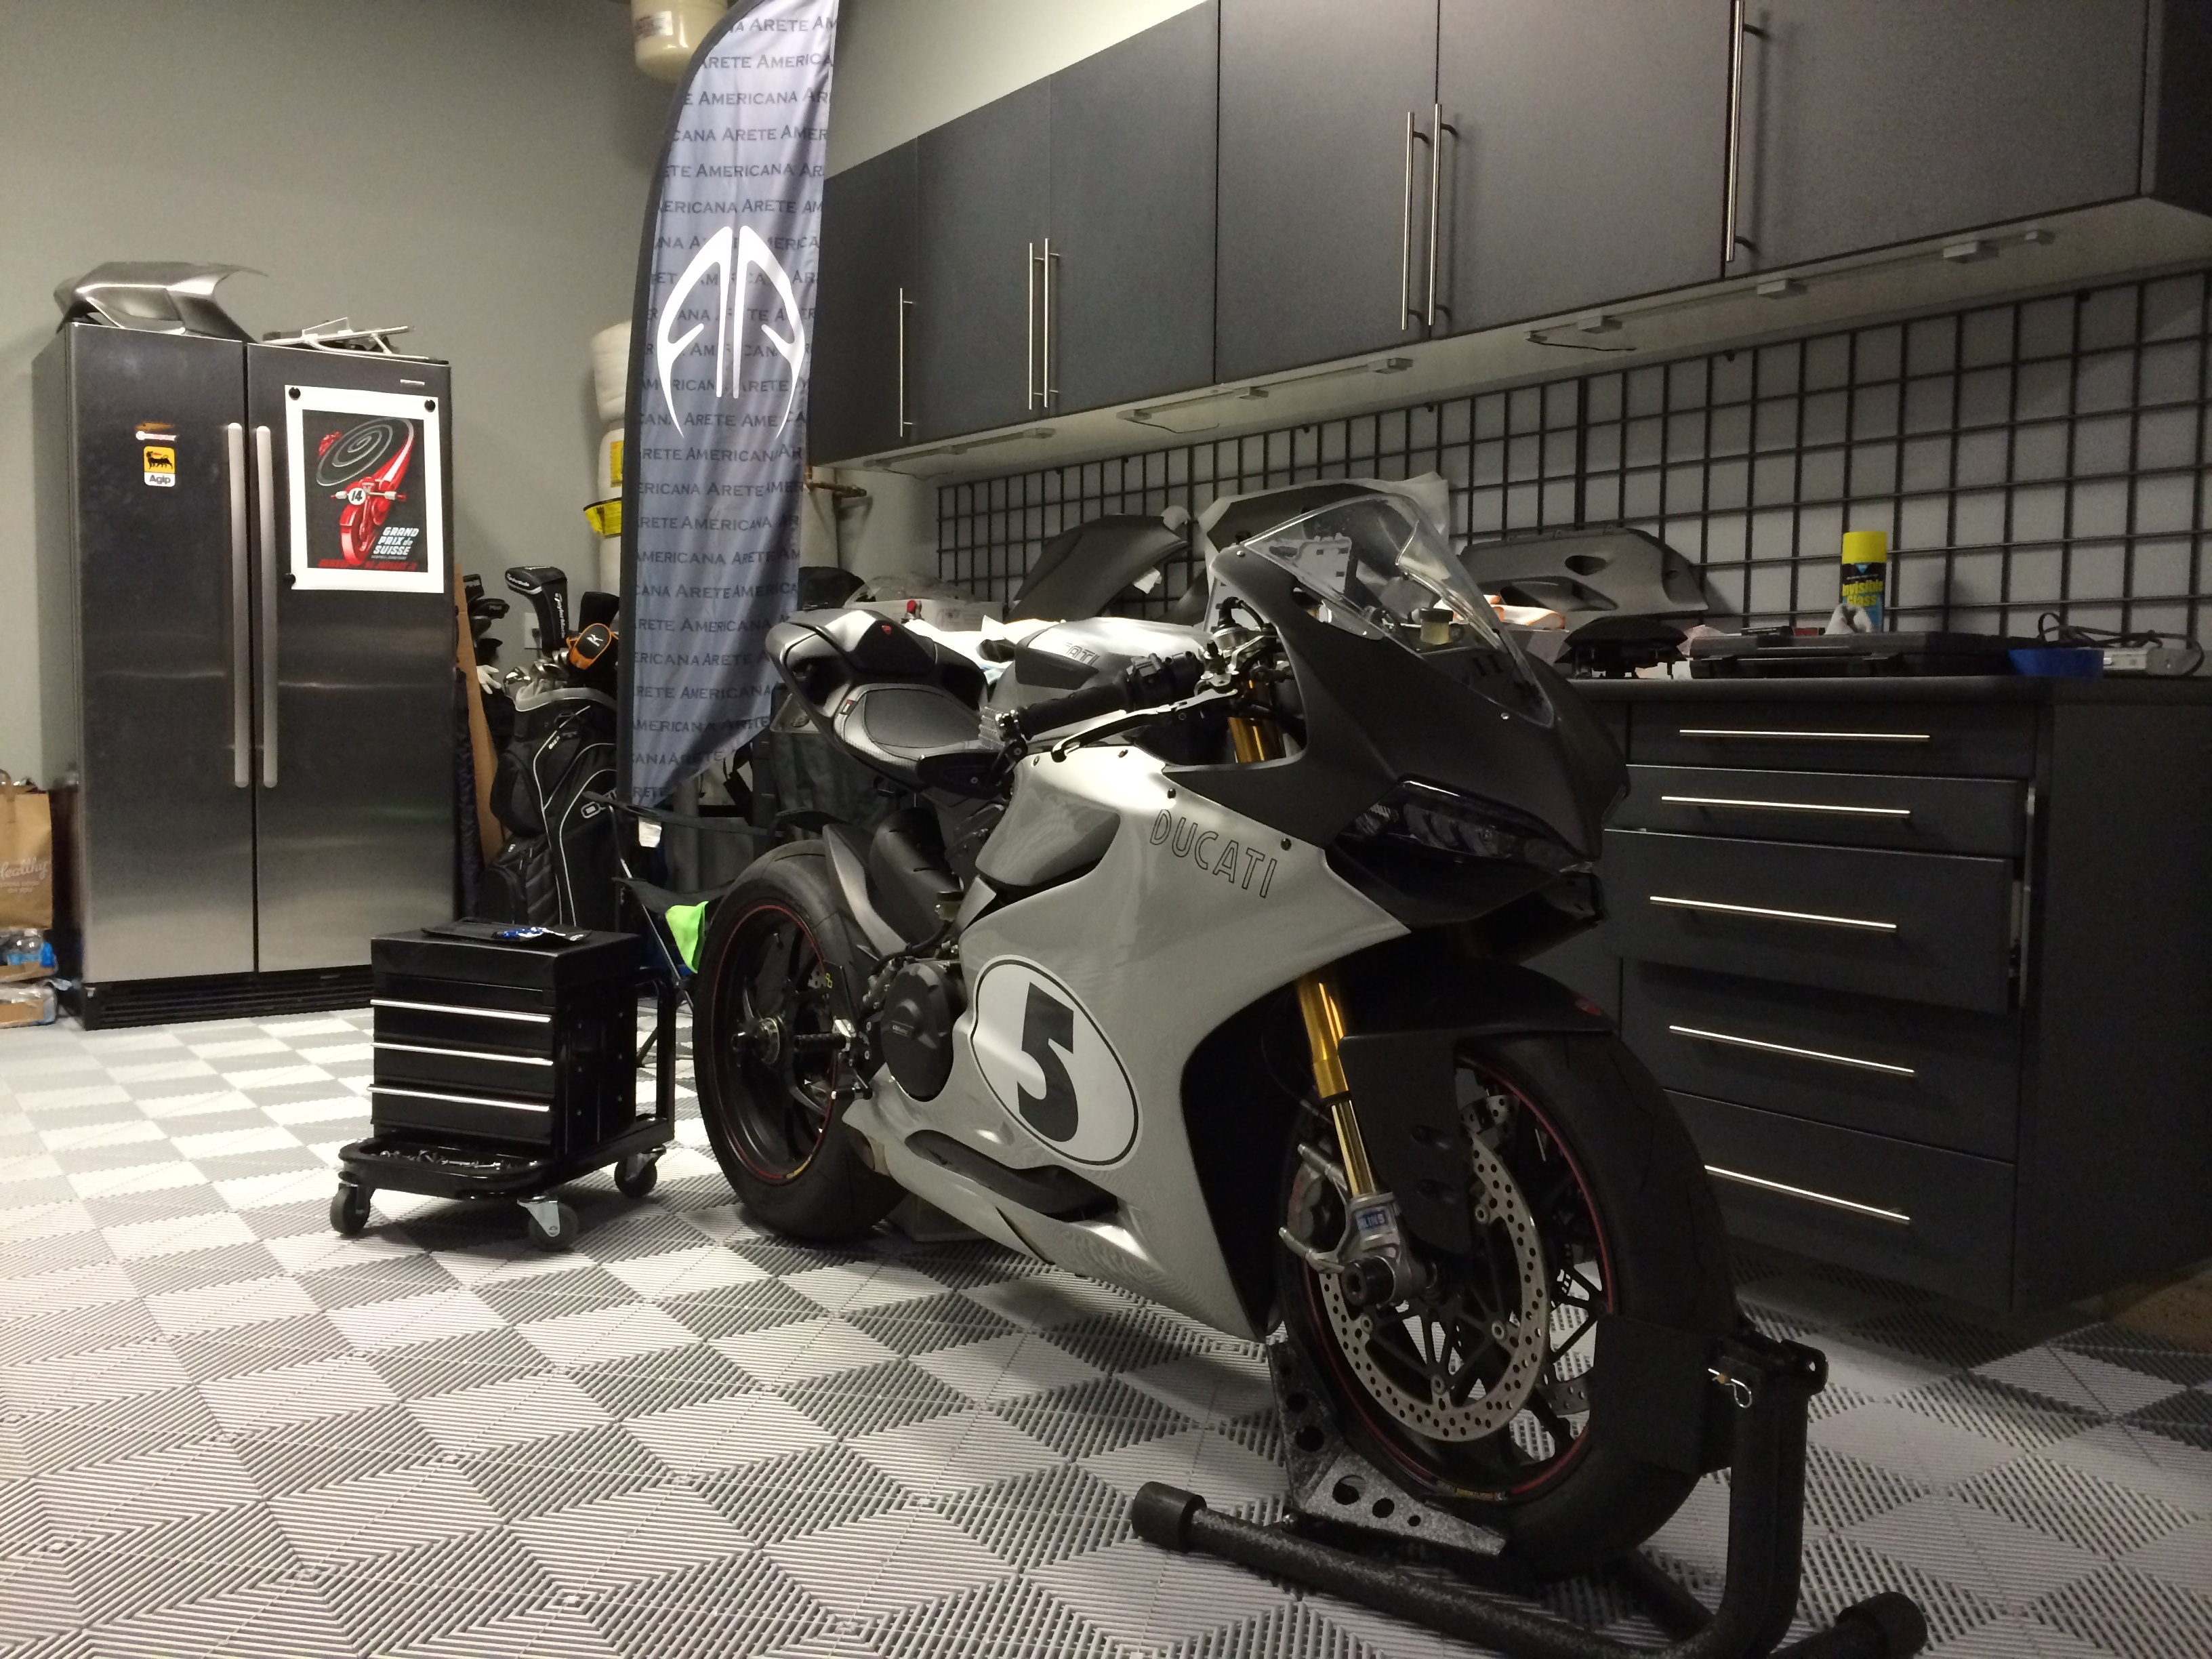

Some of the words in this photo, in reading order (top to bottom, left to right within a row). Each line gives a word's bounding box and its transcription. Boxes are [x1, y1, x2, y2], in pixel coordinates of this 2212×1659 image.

[749, 18, 808, 32] ARETE
[698, 90, 798, 105] AMERICANA
[722, 127, 777, 141] ARETE
[695, 163, 794, 178] AMERICANA
[741, 199, 796, 214] ARETE
[683, 412, 736, 427] ARETE
[149, 474, 171, 485] Agip
[351, 489, 362, 501] 14
[707, 482, 764, 497] ARETE
[681, 515, 773, 531] AMERICANA
[383, 526, 419, 537] GRAND
[377, 535, 405, 546] PRIX
[403, 537, 413, 546] de
[373, 545, 411, 556] SUISSE
[675, 583, 731, 599] ARETE
[680, 617, 773, 634] AMERICANA
[680, 684, 771, 700] AMERICANA
[1149, 808, 1278, 899] DUCATI
[1017, 981, 1079, 1143] 5
